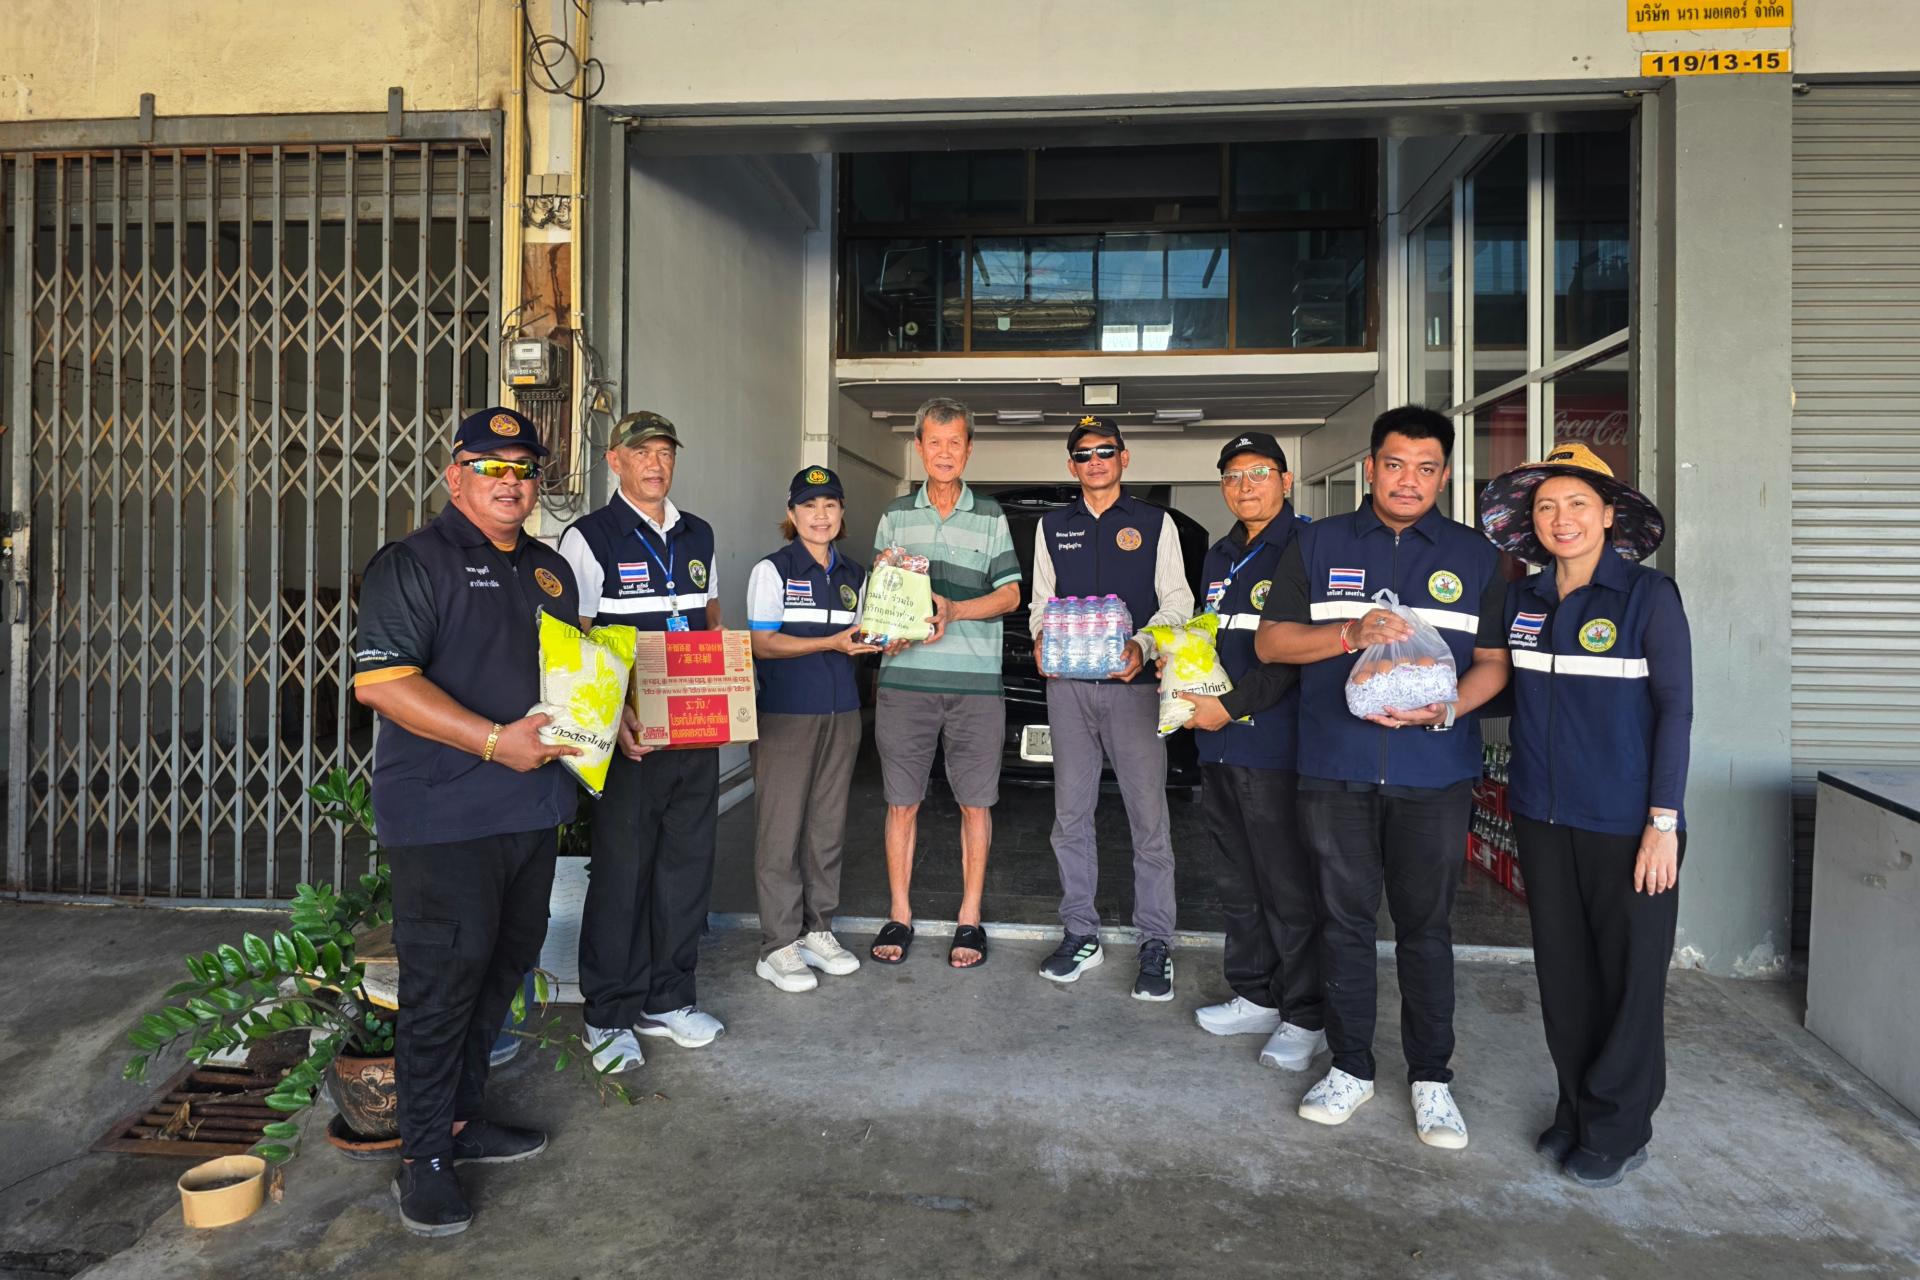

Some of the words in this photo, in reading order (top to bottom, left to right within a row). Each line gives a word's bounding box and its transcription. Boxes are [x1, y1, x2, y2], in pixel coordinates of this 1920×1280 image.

[1636, 3, 1670, 22] บริษัท
[1677, 7, 1699, 20] นรา
[1704, 1, 1748, 20] มอเตอร์
[1754, 0, 1785, 18] จำกัด
[1652, 53, 1780, 72] 119/13-15
[1554, 410, 1629, 446] Coca-Co
[1171, 682, 1227, 699] ข้าไก่แจ้
[551, 725, 613, 753] ข้าวตราไก่แจ้
